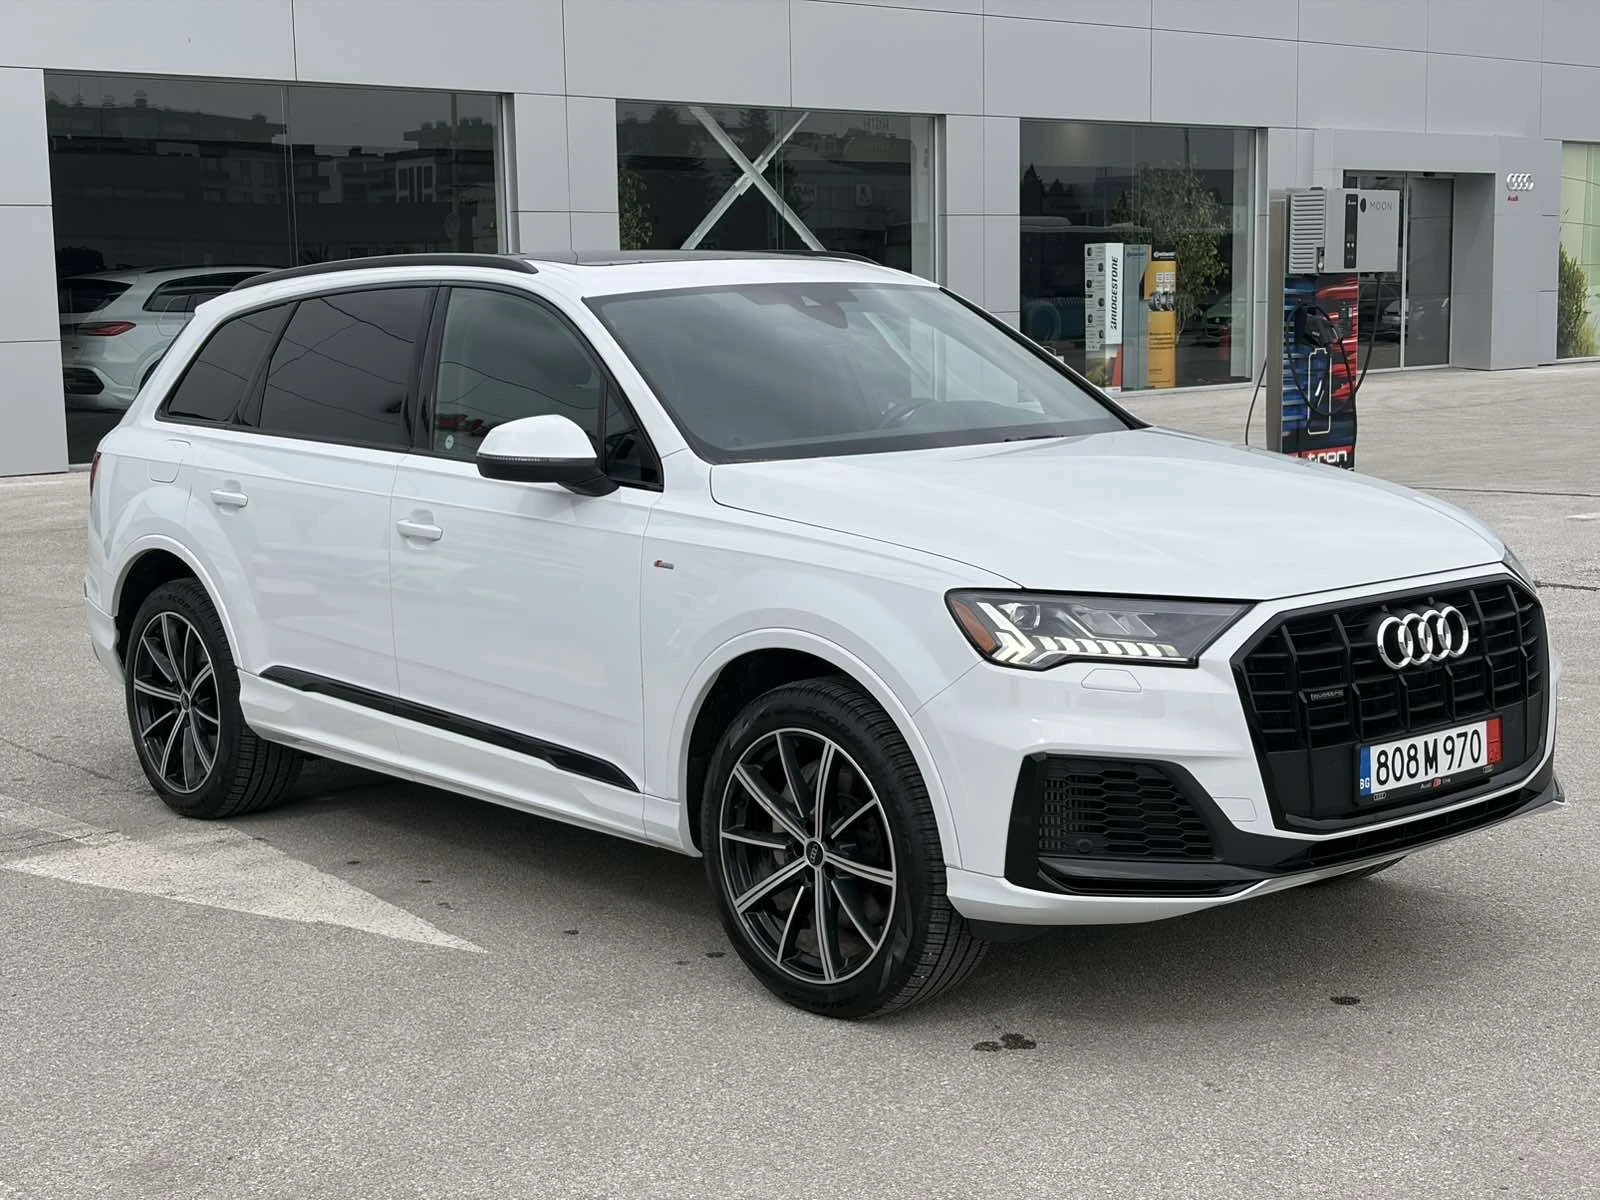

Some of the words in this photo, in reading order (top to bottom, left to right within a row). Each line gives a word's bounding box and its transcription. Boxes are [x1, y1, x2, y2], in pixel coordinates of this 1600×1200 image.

[1369, 200, 1392, 210] MOON
[1110, 255, 1119, 331] BRIDGESTONE
[1376, 743, 1420, 786] 808
[1424, 738, 1438, 776] M
[1443, 729, 1482, 771] 970
[1360, 777, 1370, 790] BG
